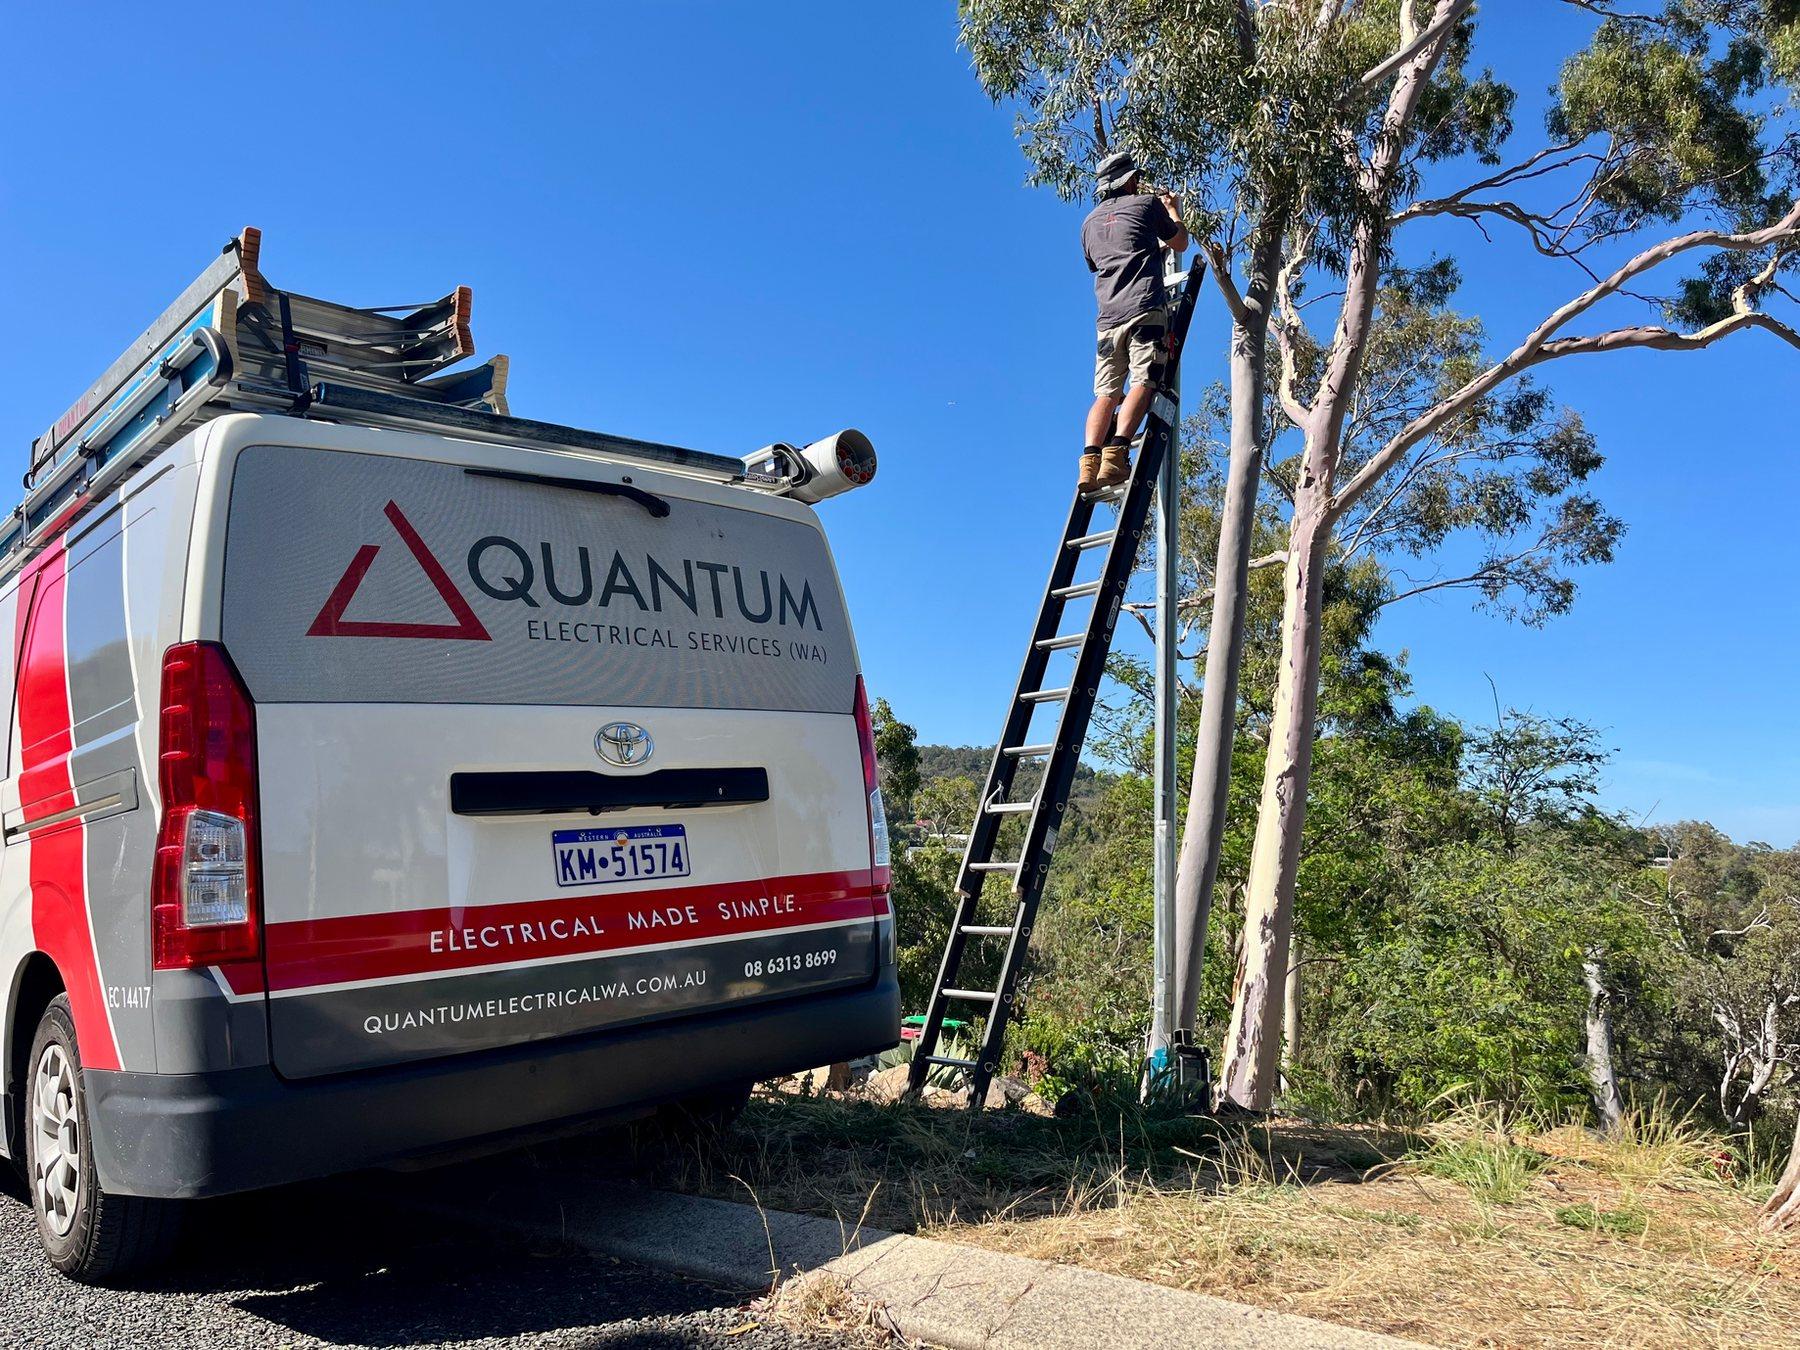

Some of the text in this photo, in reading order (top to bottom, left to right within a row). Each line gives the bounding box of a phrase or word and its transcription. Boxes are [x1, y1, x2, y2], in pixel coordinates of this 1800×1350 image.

[467, 535, 824, 631] QUANTUM
[527, 620, 828, 665] ELECTRICAL SERVICES (WA)
[578, 834, 609, 842] WESTERN
[430, 894, 802, 953] ELECTRICAL MADE SIMPLE.
[744, 949, 837, 977] 08 6313 8699
[108, 986, 151, 1008] EC 14417
[363, 970, 707, 1034] QUANTUMELECTRICALWA.COM.AU
